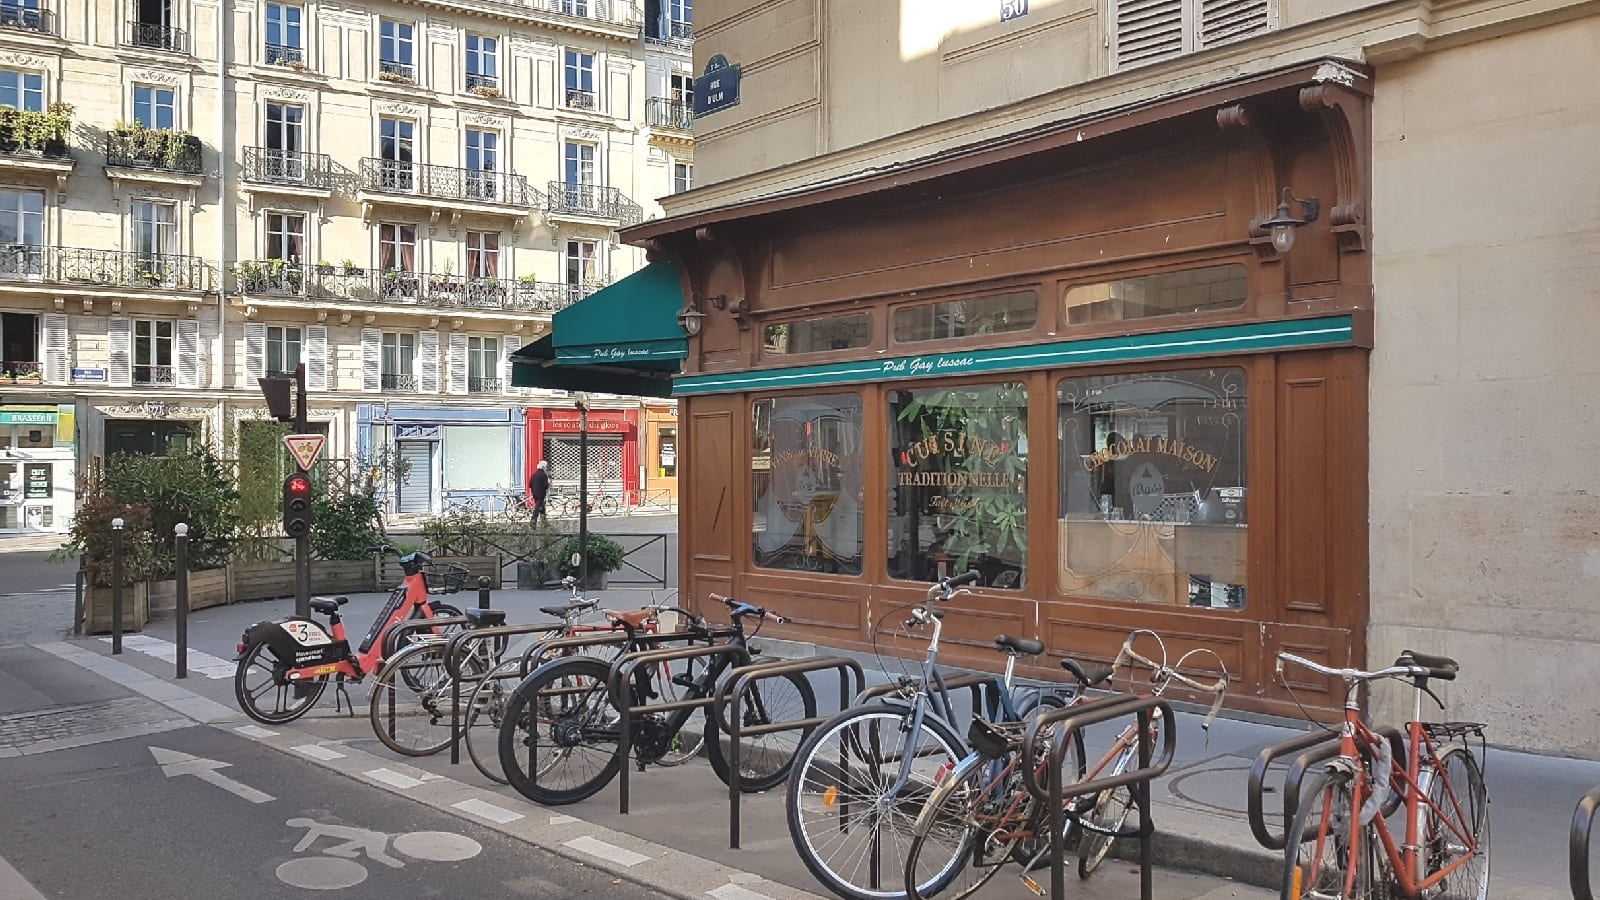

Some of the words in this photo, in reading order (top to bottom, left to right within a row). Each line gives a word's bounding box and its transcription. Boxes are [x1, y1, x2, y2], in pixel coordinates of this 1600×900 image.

[1003, 0, 1025, 18] 50
[710, 80, 720, 90] RUE
[707, 91, 724, 104] D'ULM
[593, 348, 609, 359] Pub
[610, 347, 625, 359] Gay
[883, 359, 907, 373] Pub
[909, 358, 933, 375] Gay
[552, 420, 562, 429] les
[906, 431, 1000, 469] CUISINE
[1083, 436, 1153, 472] CHOCOLAT
[1157, 437, 1218, 474] MAISON
[898, 472, 1010, 488] TRADITIONNELLE
[298, 624, 308, 642] 3
